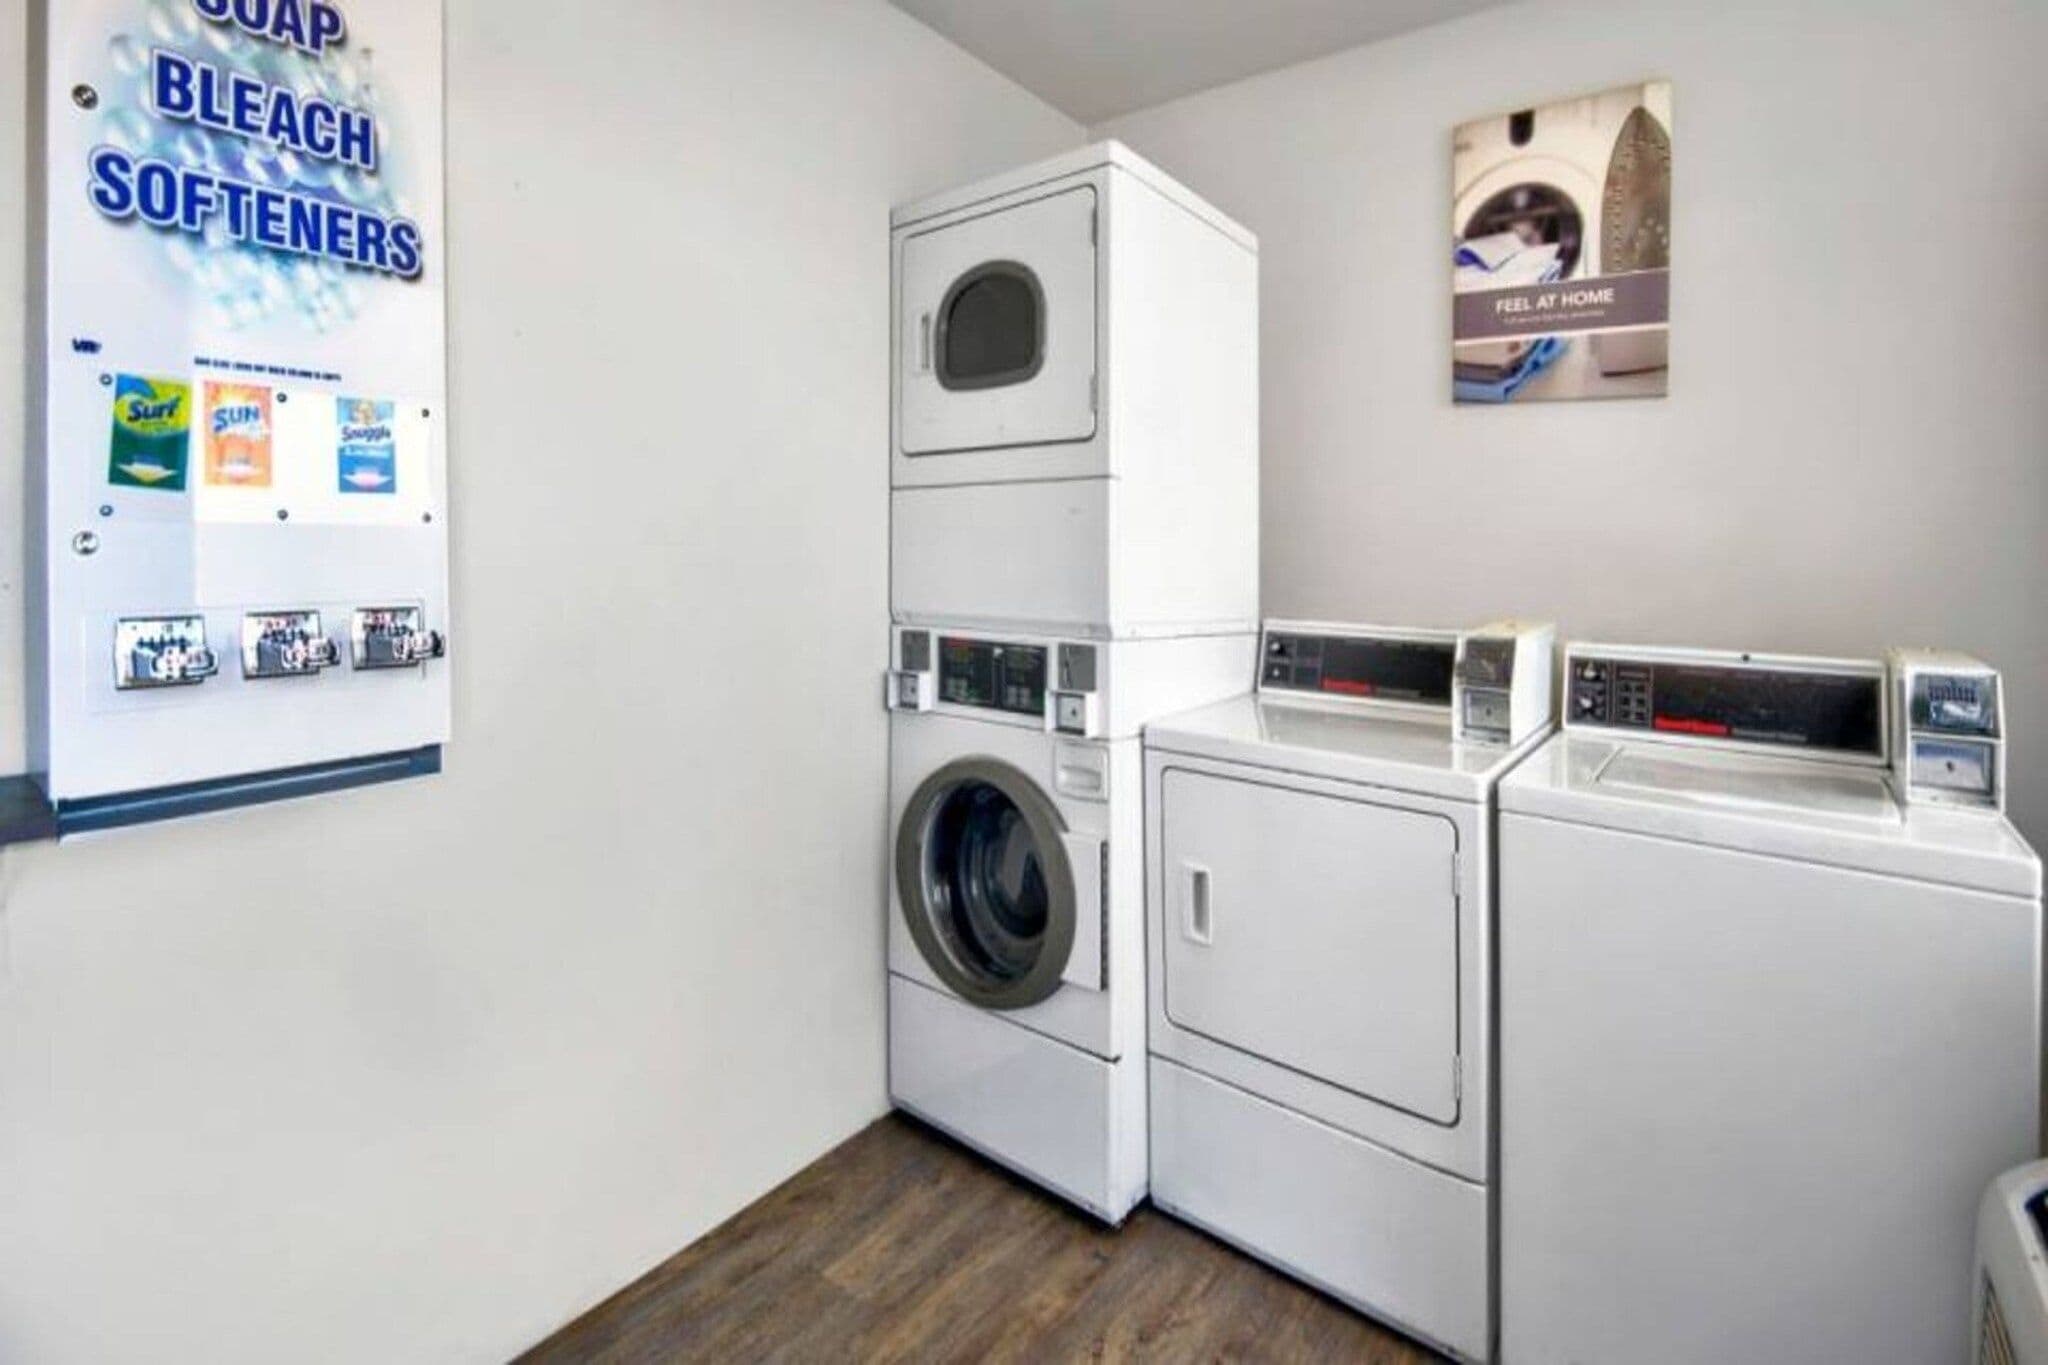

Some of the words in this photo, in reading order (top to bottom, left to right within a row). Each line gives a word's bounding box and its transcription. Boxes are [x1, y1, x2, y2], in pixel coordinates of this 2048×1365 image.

[155, 53, 374, 167] BLEACH
[91, 149, 420, 275] SOFTENERS
[1495, 297, 1532, 314] FEEL
[1536, 293, 1557, 309] AT
[1561, 287, 1615, 308] HOME
[127, 396, 181, 422] Surf
[213, 405, 260, 433] SUN
